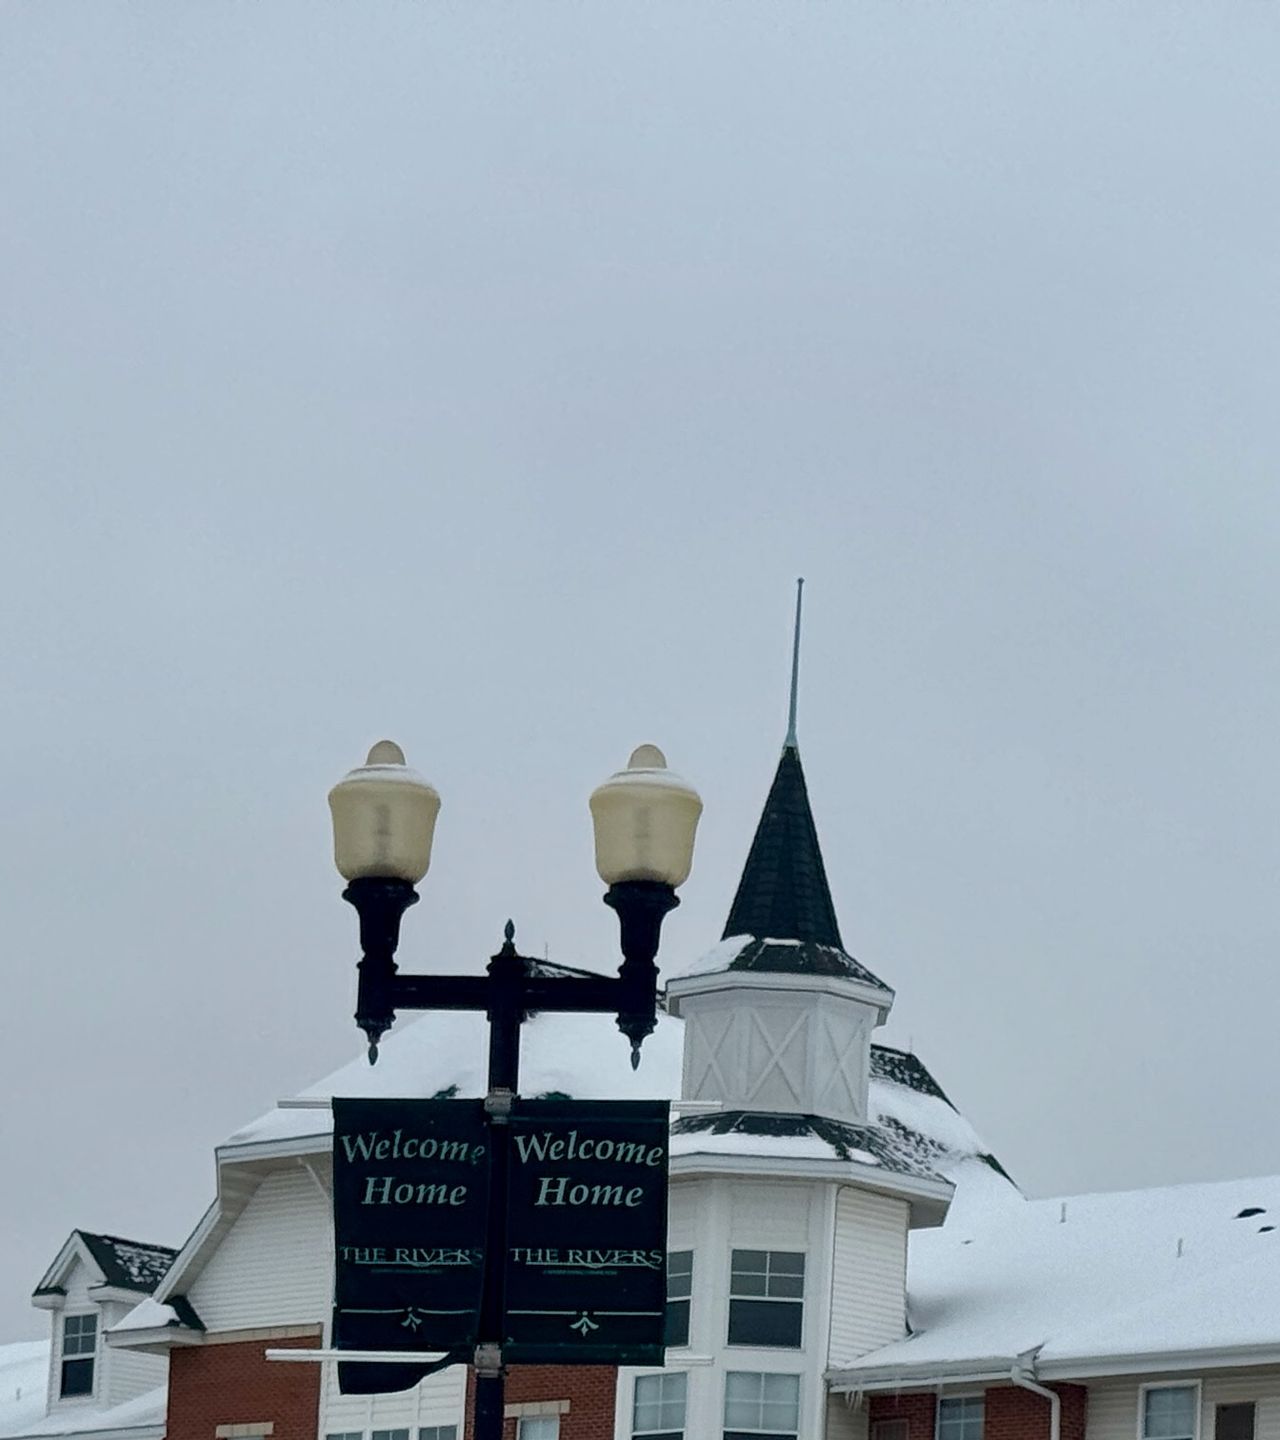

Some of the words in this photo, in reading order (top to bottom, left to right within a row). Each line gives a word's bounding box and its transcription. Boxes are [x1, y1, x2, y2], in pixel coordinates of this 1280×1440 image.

[340, 1129, 486, 1166] Welcome
[514, 1131, 664, 1167] Welcome
[361, 1176, 468, 1206] Home
[534, 1177, 644, 1207] Home
[340, 1247, 394, 1263] THE
[395, 1248, 483, 1265] RIVERS
[509, 1248, 560, 1263] THE
[568, 1248, 663, 1266] RIVERS
